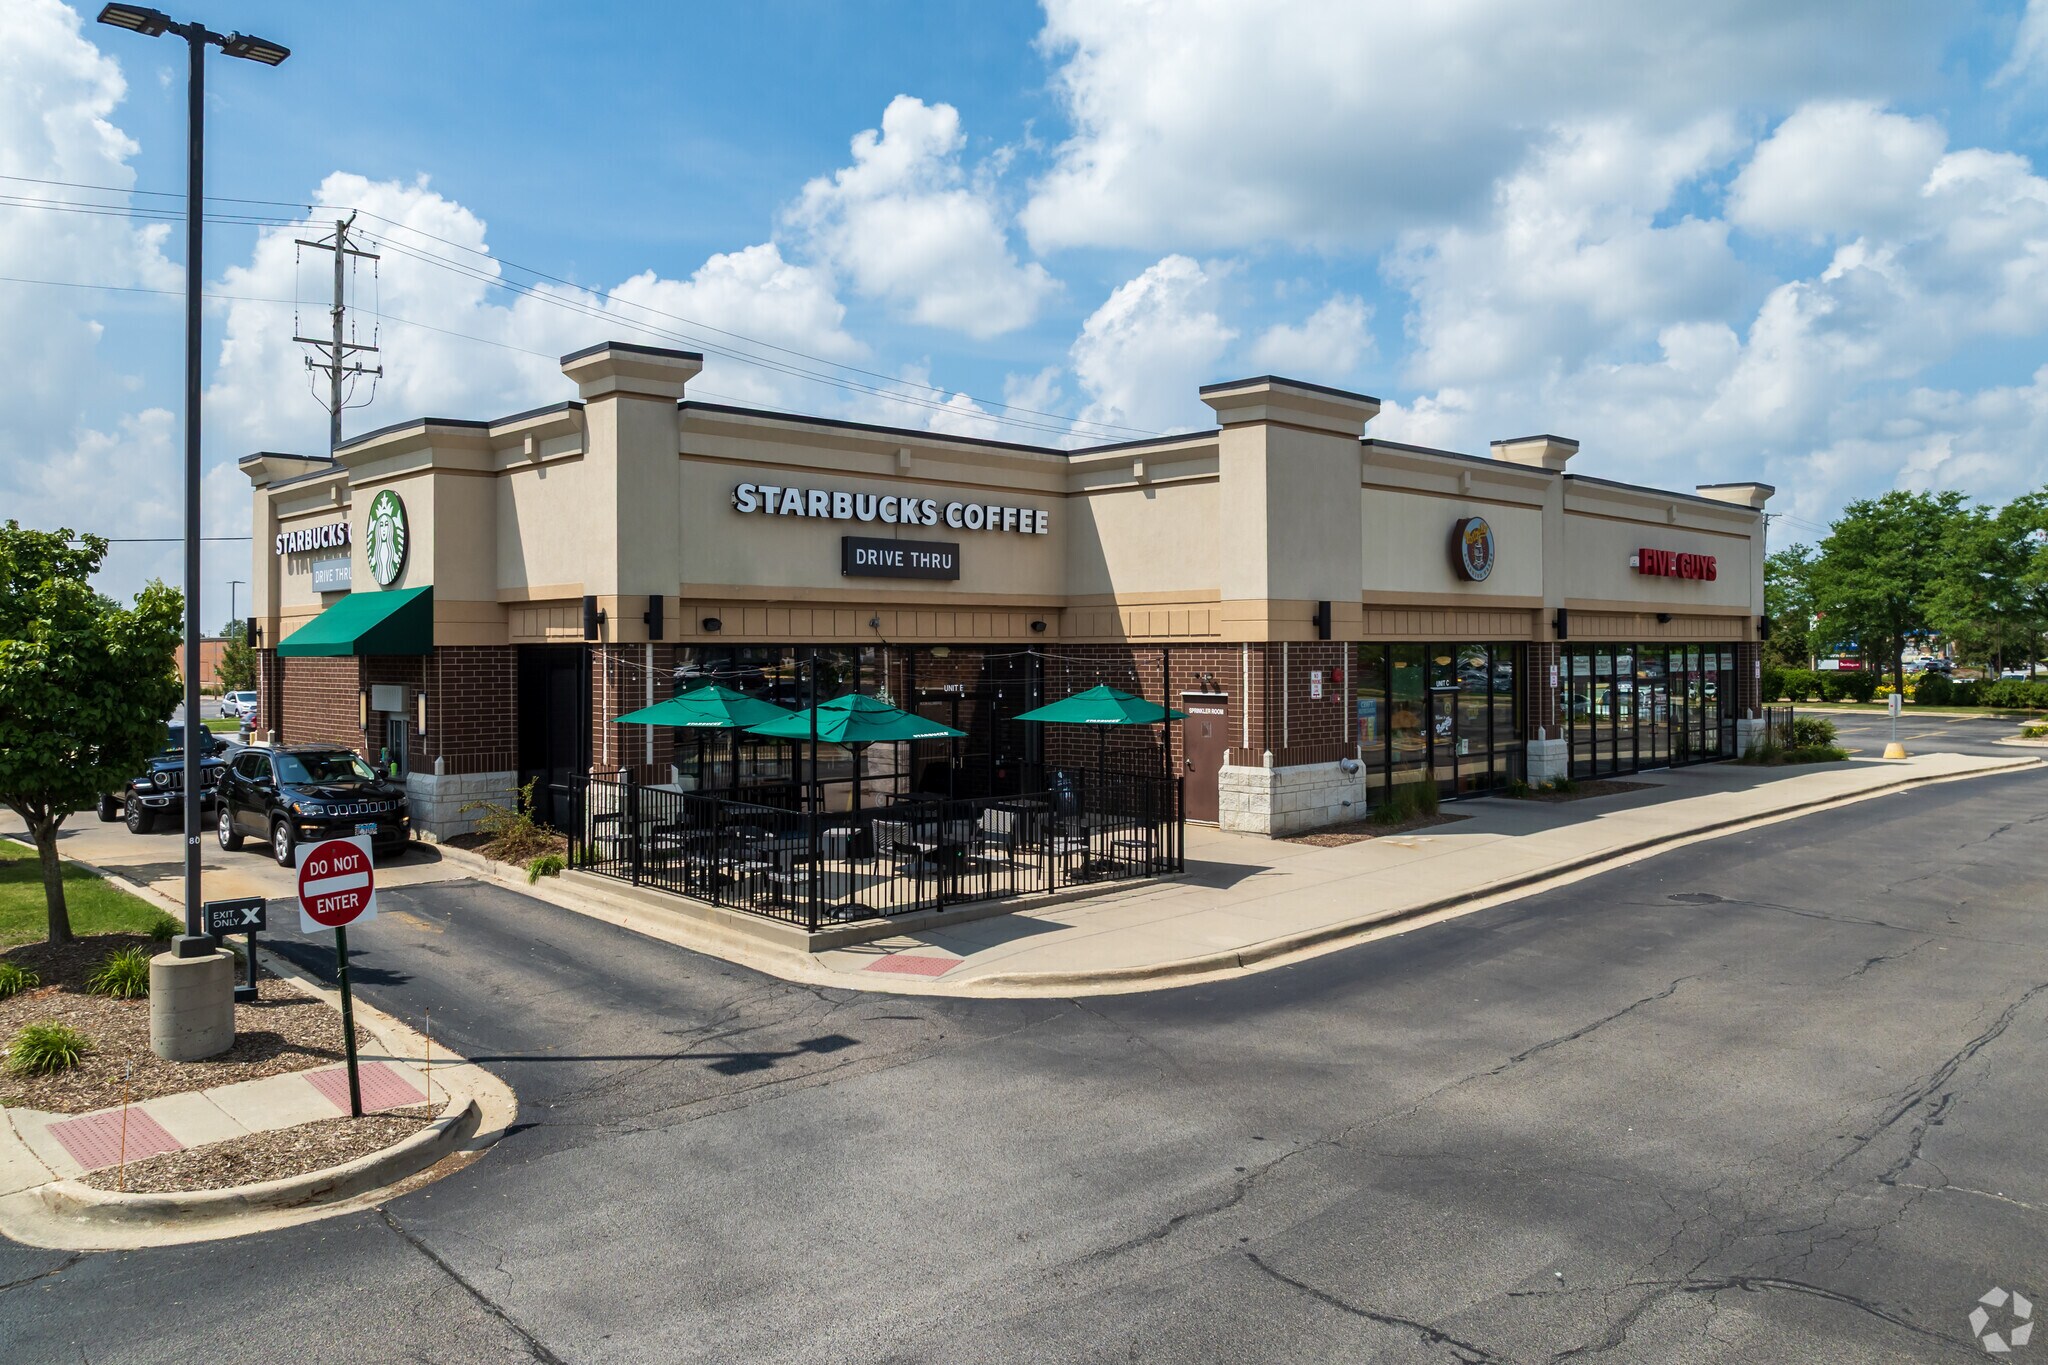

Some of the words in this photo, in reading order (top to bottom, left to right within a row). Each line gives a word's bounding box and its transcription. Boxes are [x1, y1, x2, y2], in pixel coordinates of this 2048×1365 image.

[735, 483, 939, 526] STARBUCKS
[944, 501, 1049, 535] COFFEE
[276, 522, 345, 555] STARBUCKS
[856, 548, 904, 567] DRIVE
[911, 551, 952, 570] THRU
[1640, 548, 1677, 577] FIVE
[1677, 553, 1717, 581] GUYS
[315, 568, 333, 583] DRIVE
[943, 684, 959, 692] UNIT
[959, 684, 965, 692] E
[1445, 679, 1450, 687] C
[1188, 707, 1211, 715] SPRINKLER
[188, 836, 201, 845] 80
[309, 860, 328, 876] DO
[334, 854, 360, 872] NOT
[316, 893, 359, 914] ENTER
[213, 909, 235, 920] EXIT
[213, 917, 240, 928] ONLY
